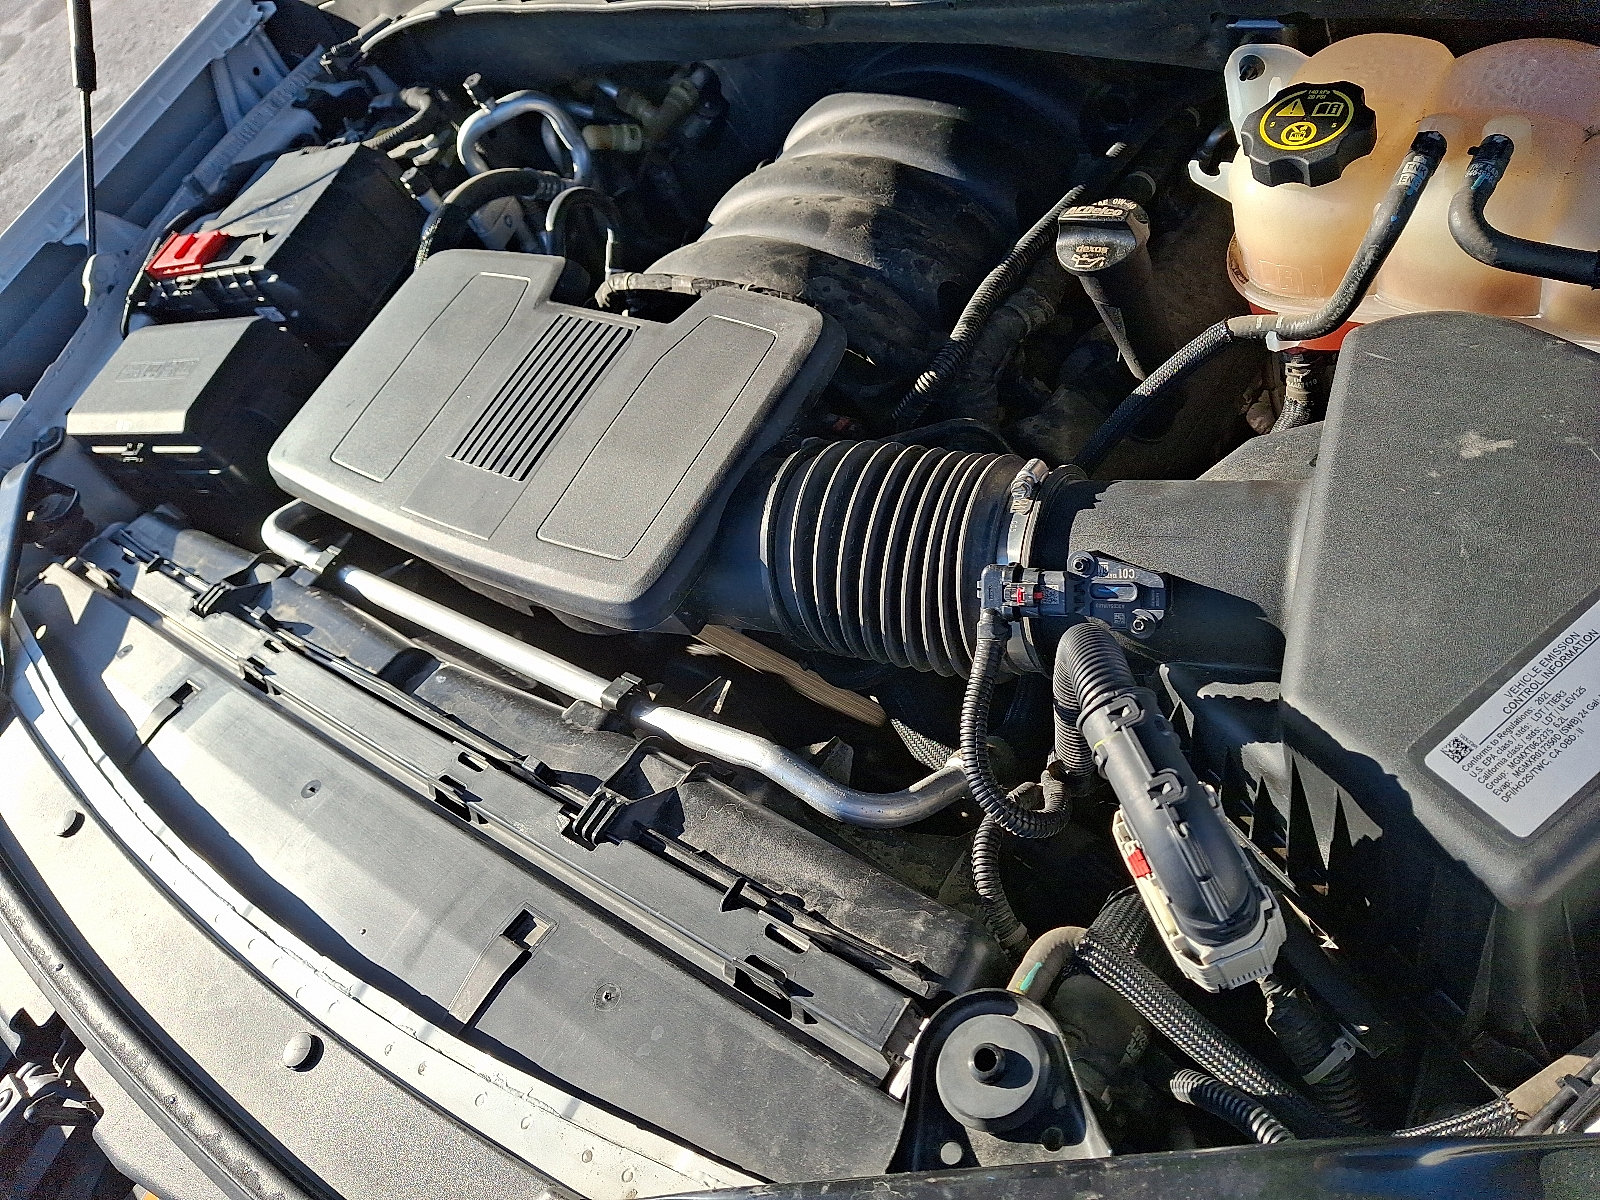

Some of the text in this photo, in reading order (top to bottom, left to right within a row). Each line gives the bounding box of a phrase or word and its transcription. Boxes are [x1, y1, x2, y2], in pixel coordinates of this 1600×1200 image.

[1064, 206, 1124, 216] ACDelco
[1076, 245, 1109, 253] dexos
[1503, 629, 1599, 714] CONTROL INFORMATION
[1504, 631, 1580, 698] VEHICLE EMISSION
[1462, 744, 1492, 772] Conforms
[1490, 738, 1499, 746] to
[1496, 706, 1535, 742] Regulations:
[1535, 691, 1552, 705] 2021
[1469, 766, 1484, 778] U.S.
[1481, 753, 1497, 767] EPA
[1496, 739, 1513, 755] class
[1515, 722, 1532, 738] stds:
[1531, 708, 1546, 722] LDT
[1546, 690, 1567, 707] TIER3
[1477, 757, 1508, 784] California
[1506, 743, 1524, 759] class
[1525, 726, 1542, 741] stds:
[1541, 712, 1556, 726] LDT
[1557, 685, 1587, 711] ULEV125
[1485, 769, 1509, 790] Group:
[1552, 716, 1569, 728] 6.2L
[1492, 779, 1513, 796] Evap:
[1558, 716, 1583, 737] (SWB)
[1577, 709, 1589, 718] 24
[1549, 748, 1562, 758] CA
[1560, 733, 1580, 749] OBD:
